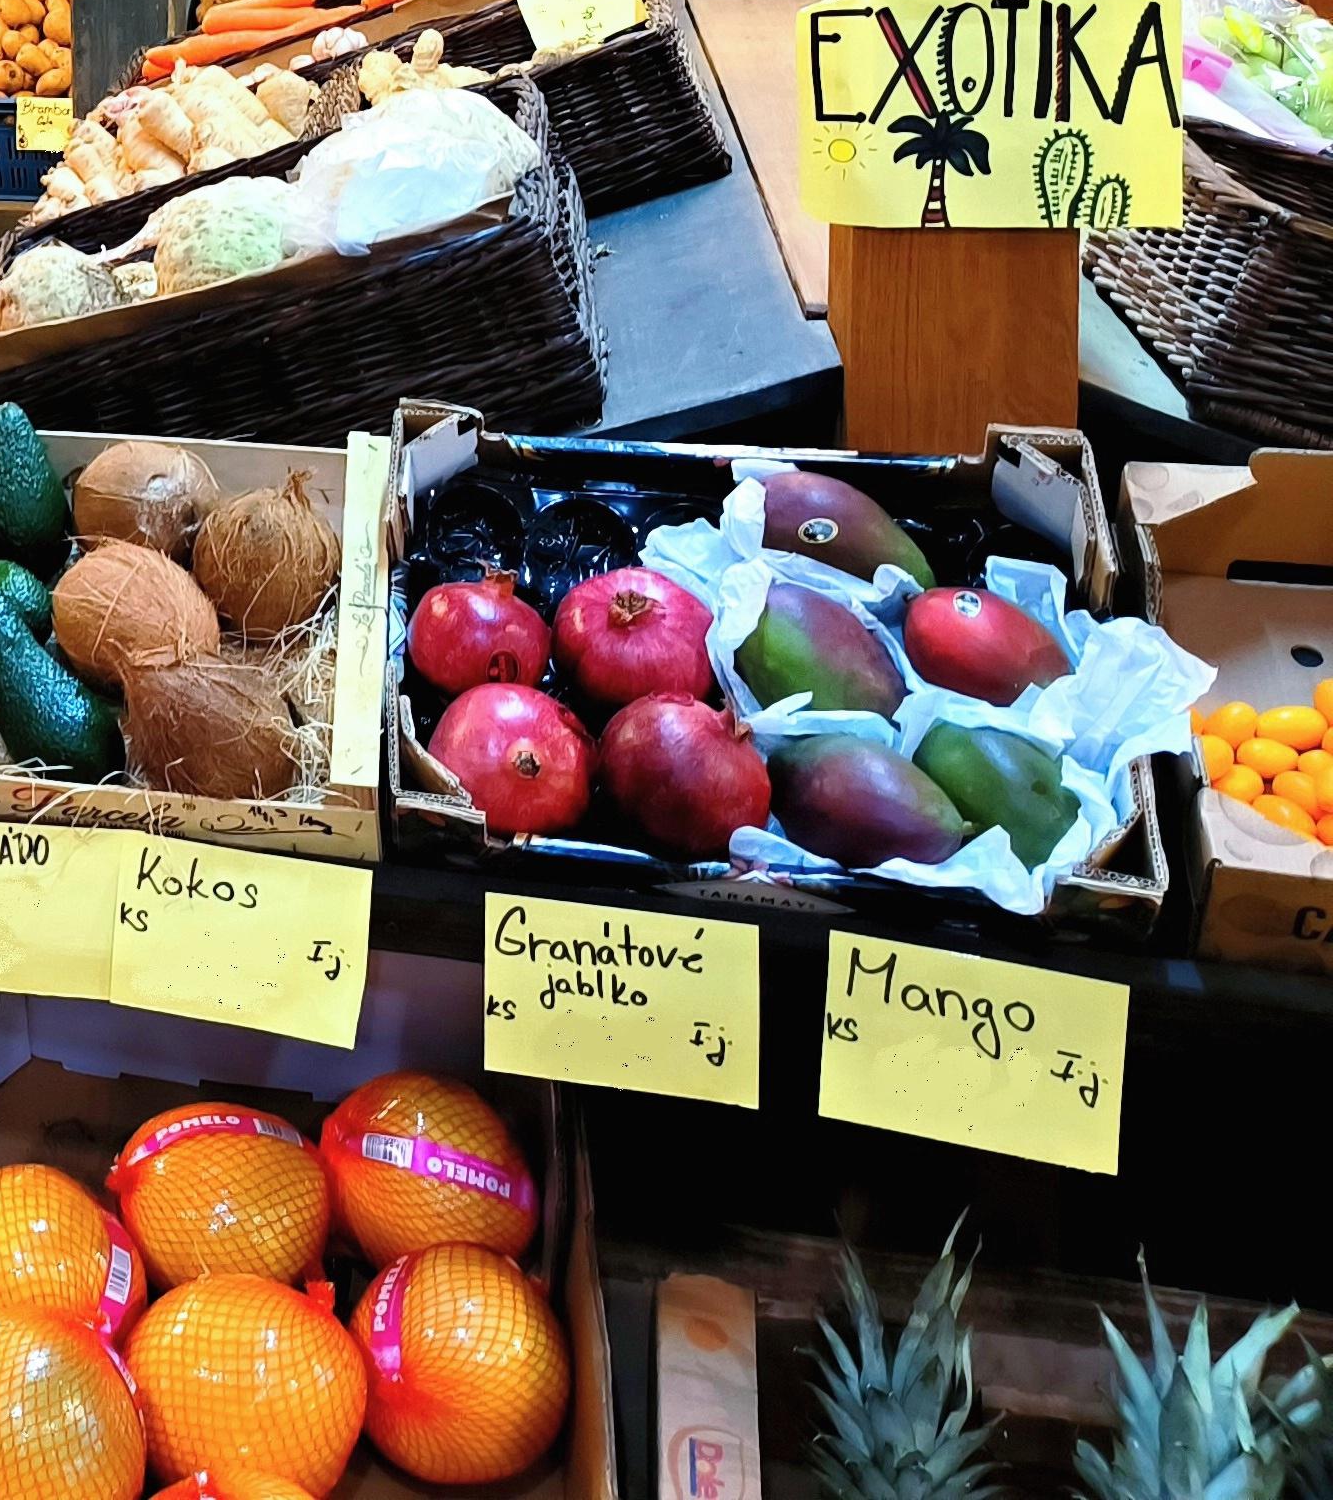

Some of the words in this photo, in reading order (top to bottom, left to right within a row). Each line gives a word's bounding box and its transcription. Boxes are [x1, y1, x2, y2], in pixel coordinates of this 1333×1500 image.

[136, 847, 258, 909] Kokos
[495, 906, 704, 973] Granátové
[540, 963, 648, 1009] jablko
[846, 947, 1035, 1060] Mango
[155, 1115, 240, 1140] POMELO
[426, 1155, 511, 1198] POMELO
[373, 1255, 409, 1332] POMEL
